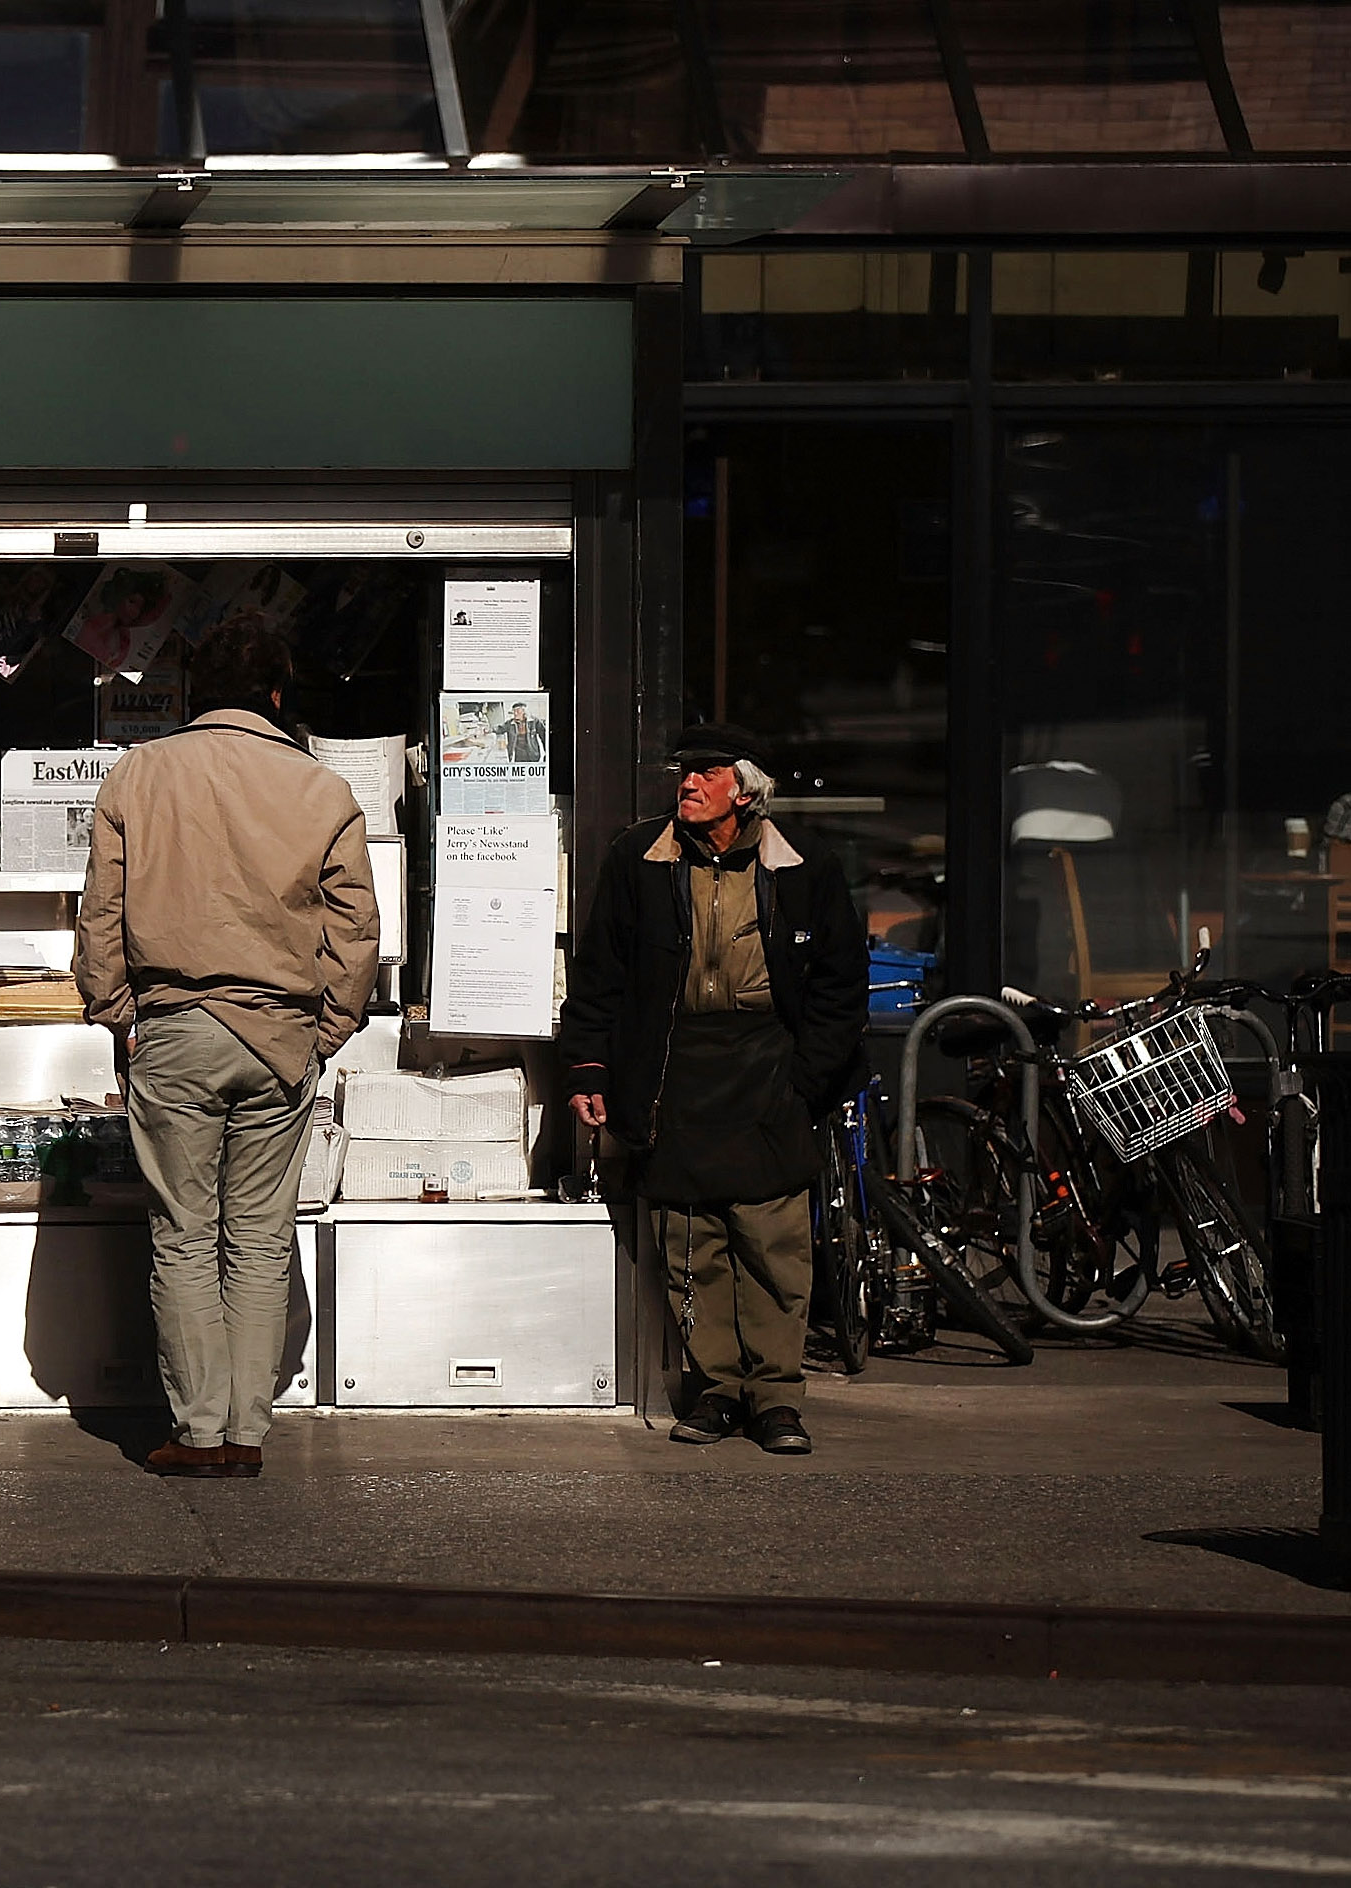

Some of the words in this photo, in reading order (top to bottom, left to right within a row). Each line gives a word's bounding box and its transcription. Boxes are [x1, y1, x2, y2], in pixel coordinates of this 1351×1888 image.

[443, 766, 471, 777] CITY'S
[473, 766, 509, 777] TOSSIN'
[511, 766, 526, 777] ME
[528, 766, 546, 777] OUT
[446, 825, 476, 836] Please
[446, 839, 478, 851] Jerry's
[479, 839, 529, 849] Newsstand
[446, 853, 458, 861] on
[460, 851, 474, 861] the
[476, 851, 518, 861] facebook
